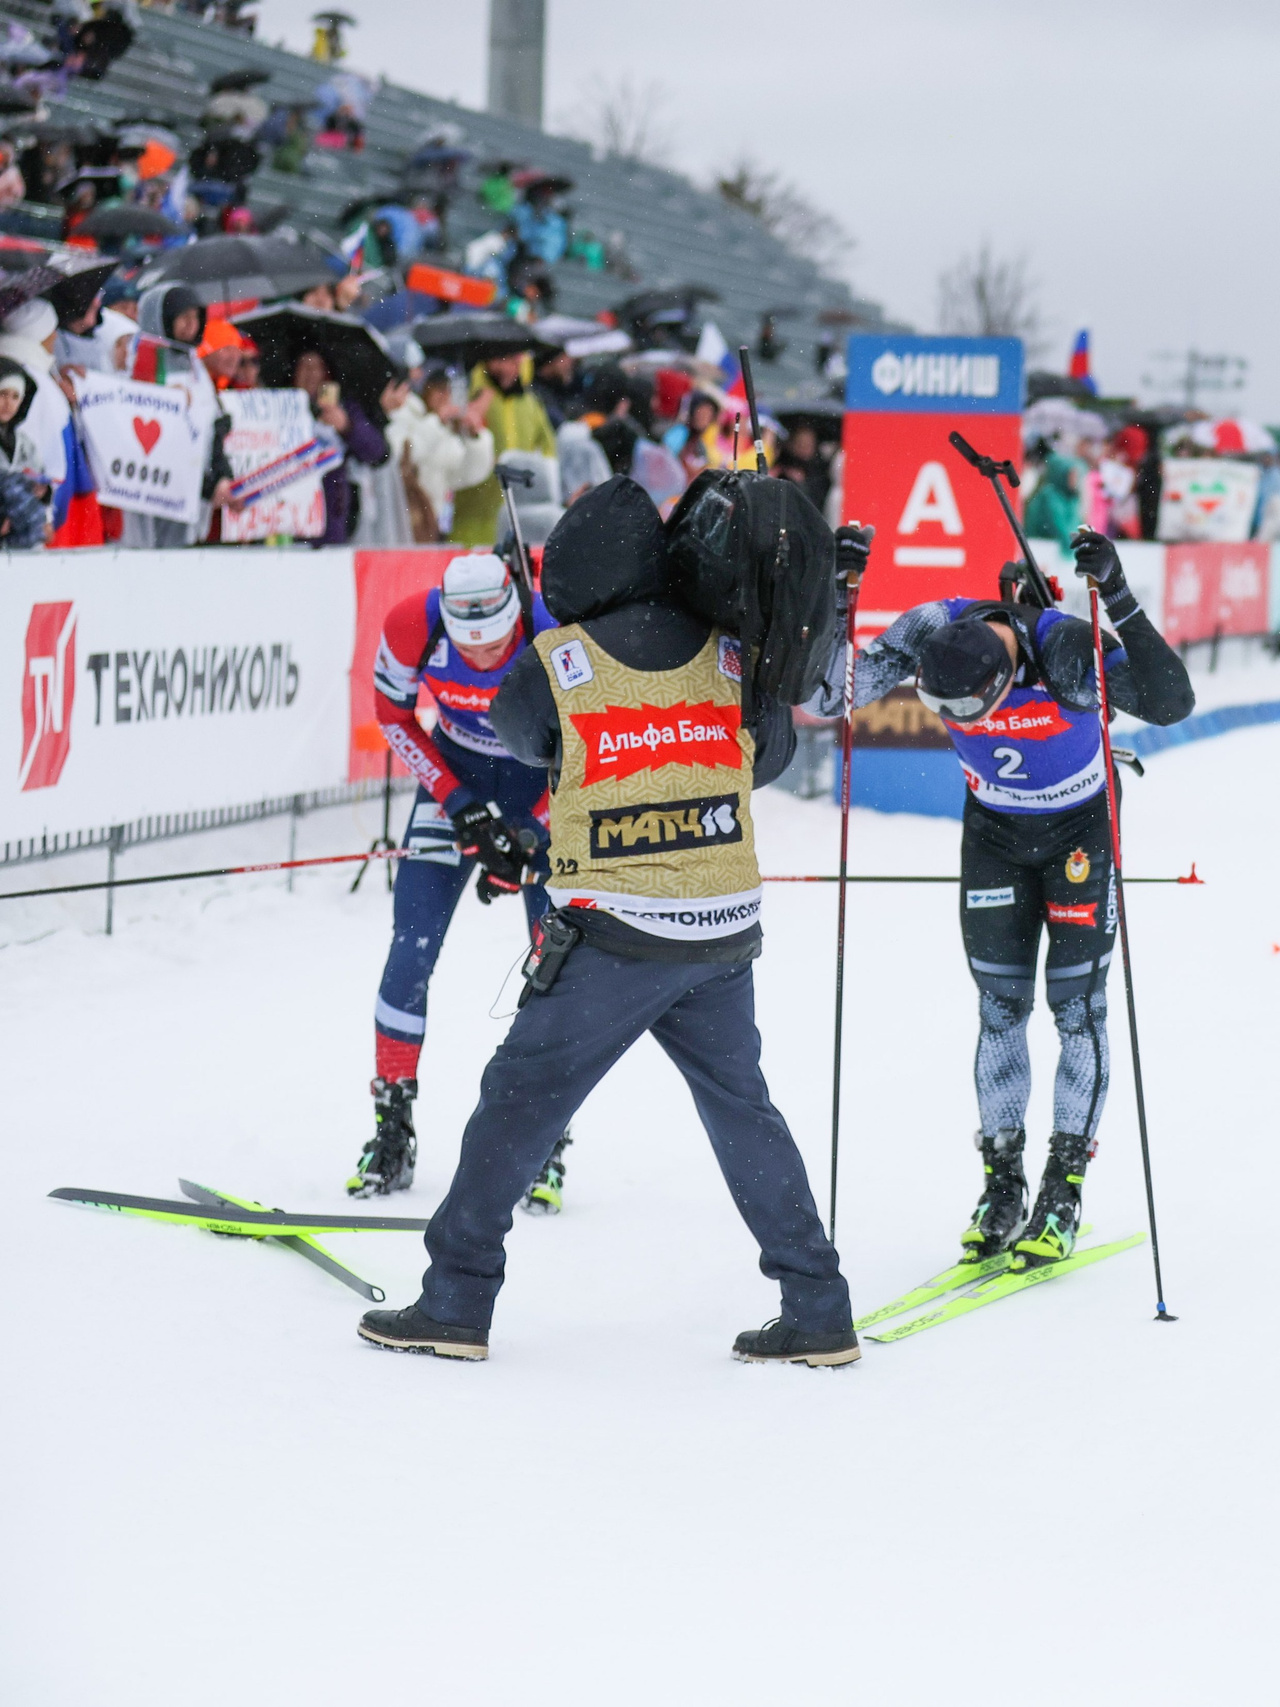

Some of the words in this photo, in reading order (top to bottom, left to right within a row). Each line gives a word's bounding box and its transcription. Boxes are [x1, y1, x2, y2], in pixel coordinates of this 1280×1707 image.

[872, 352, 998, 396] ФИНИШ
[86, 642, 299, 726] ТЕХНОНИКОЛЬ
[598, 723, 676, 755] Альфа
[678, 720, 729, 742] Банк
[1008, 715, 1053, 730] Банк
[992, 746, 1030, 780] 2
[597, 808, 703, 848] МАТЧ
